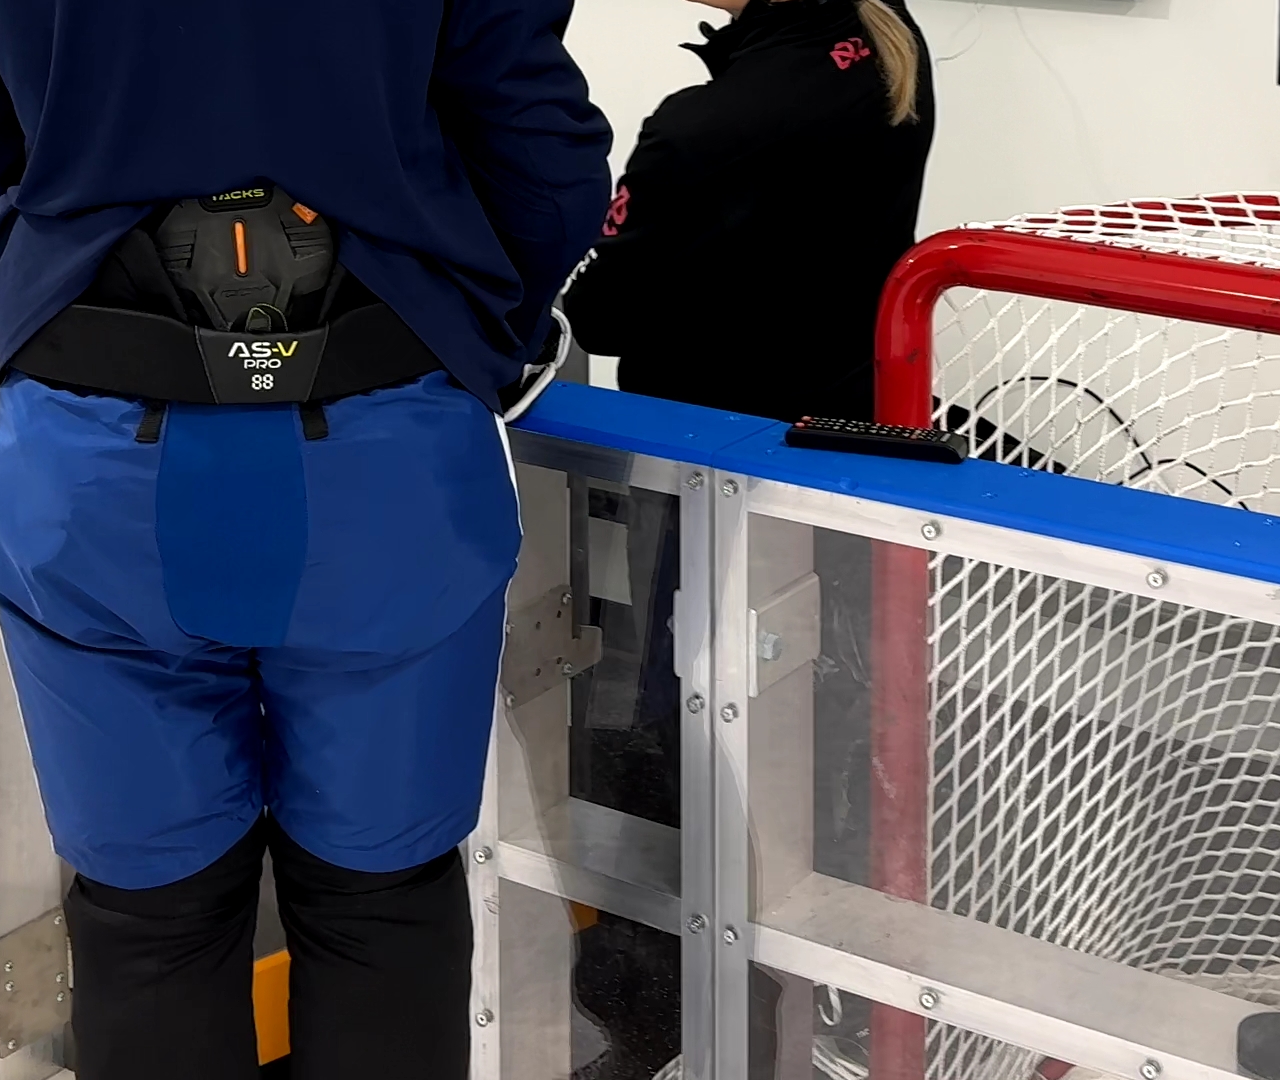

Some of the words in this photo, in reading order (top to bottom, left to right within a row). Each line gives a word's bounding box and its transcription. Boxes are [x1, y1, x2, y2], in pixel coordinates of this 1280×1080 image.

[228, 340, 299, 358] AS-V
[243, 358, 282, 369] PRO
[251, 373, 274, 390] 88
